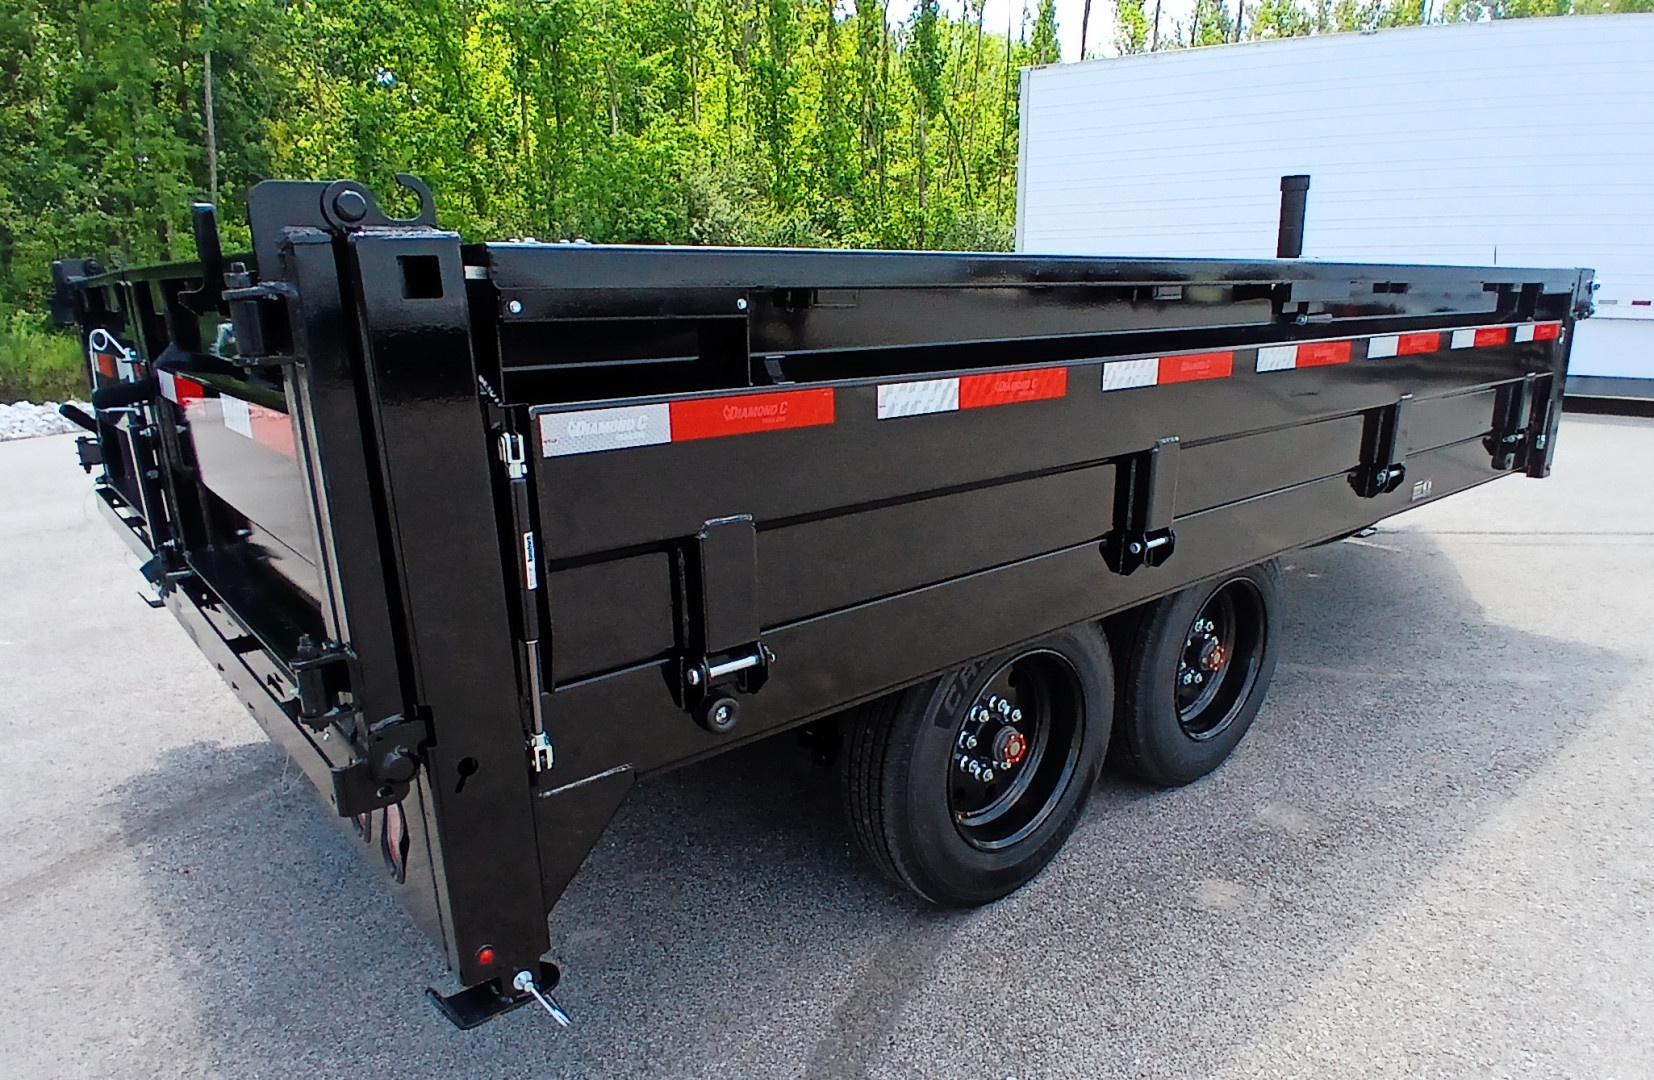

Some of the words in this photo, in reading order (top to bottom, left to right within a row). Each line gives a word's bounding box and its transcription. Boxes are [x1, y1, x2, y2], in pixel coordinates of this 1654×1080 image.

[729, 403, 778, 420] DIAMOND
[779, 400, 789, 415] C
[575, 417, 635, 436] DIAMOND
[637, 415, 649, 430] C
